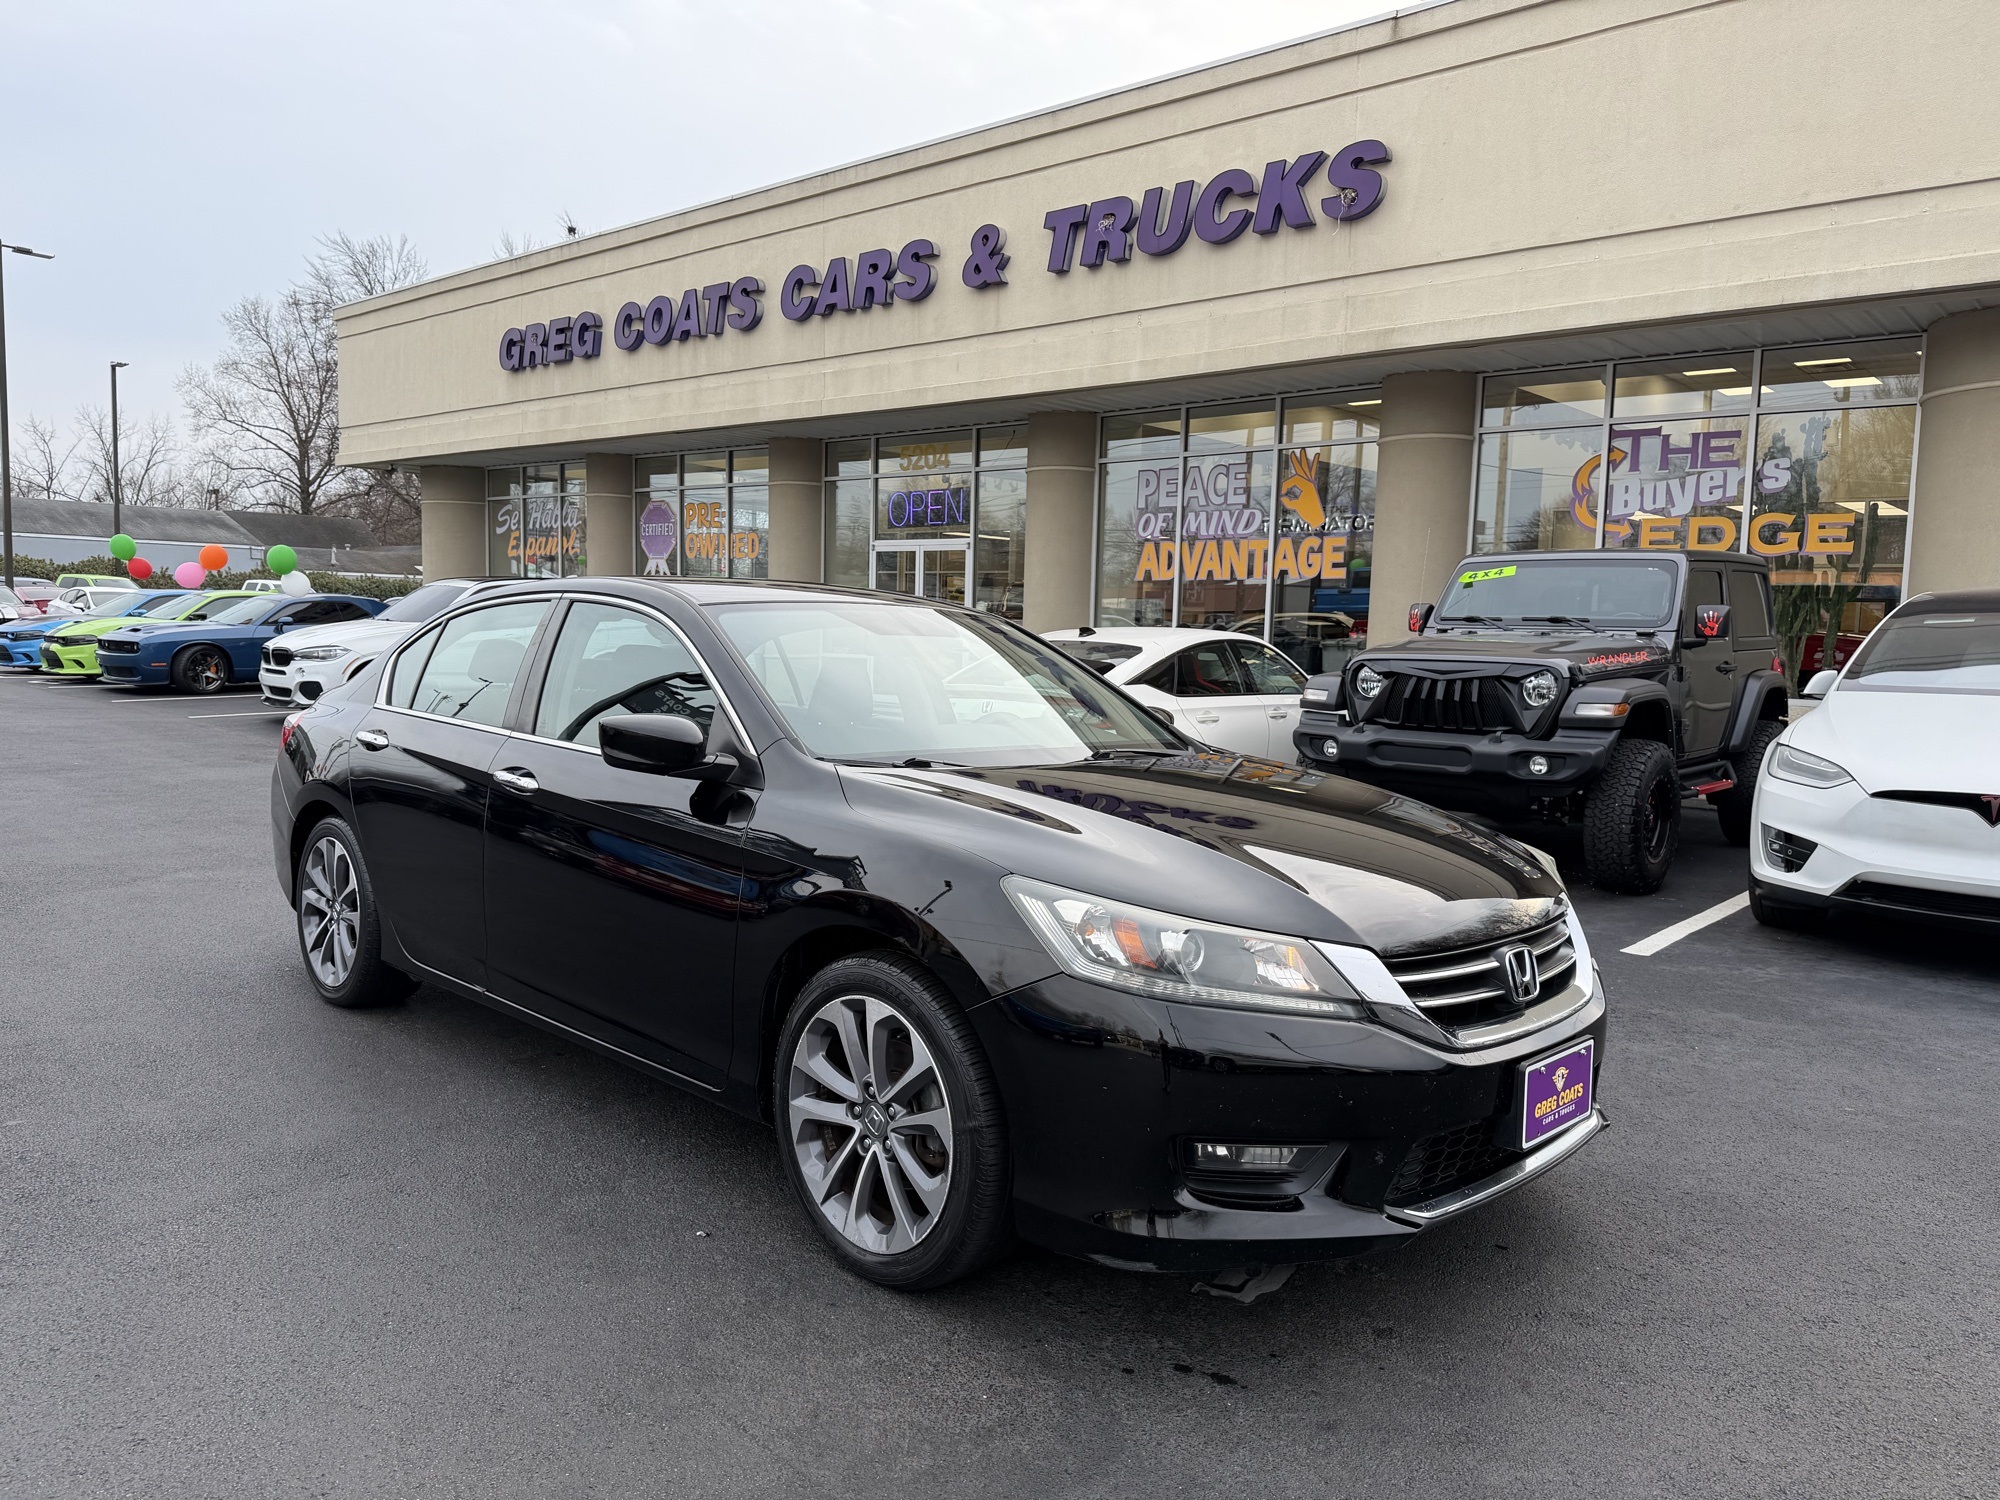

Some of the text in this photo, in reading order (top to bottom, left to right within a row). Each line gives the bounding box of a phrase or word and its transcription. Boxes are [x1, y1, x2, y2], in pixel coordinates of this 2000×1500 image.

[500, 139, 1393, 372] GREG COATS CARS & TRUCKS
[899, 444, 949, 471] 5204
[1612, 427, 1742, 473] THE
[1137, 463, 1249, 510] PEACE
[495, 500, 582, 534] Se Habla
[684, 502, 727, 529] PRE-
[888, 488, 964, 527] OPEN
[1136, 510, 1262, 540] OF MIND
[641, 523, 675, 536] CERTIFIED
[685, 531, 759, 559] OWNED
[1638, 512, 1855, 555] EDGE
[1134, 536, 1348, 581] ADVANTAGE
[1587, 650, 1652, 667] WRANGLER
[1534, 1082, 1584, 1118] GREG COATS
